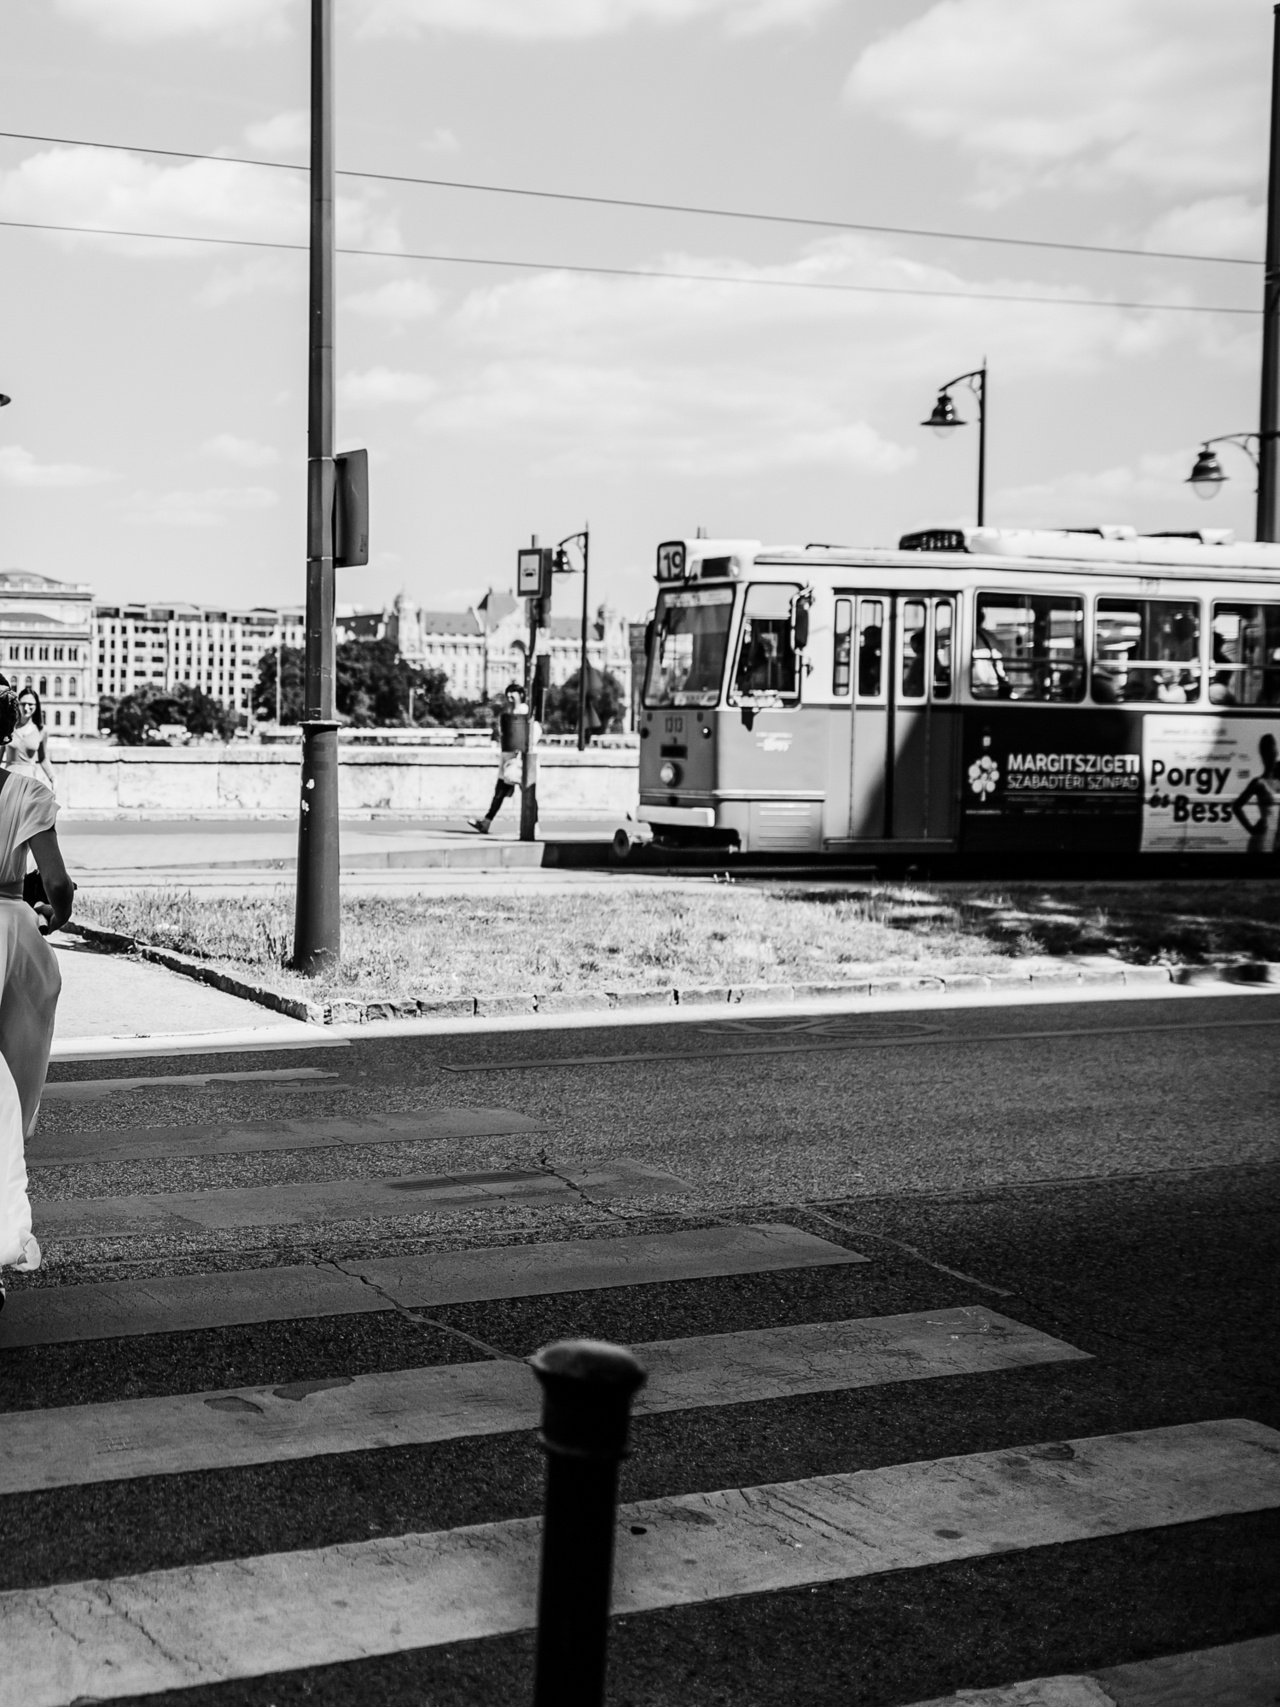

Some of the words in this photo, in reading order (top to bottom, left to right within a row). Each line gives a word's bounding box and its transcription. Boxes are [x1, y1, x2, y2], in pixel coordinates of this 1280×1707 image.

[663, 550, 683, 578] 19
[1007, 753, 1140, 774] MARGITSZIGETI
[1150, 759, 1232, 795] Porgy
[1173, 794, 1233, 823] Bess
